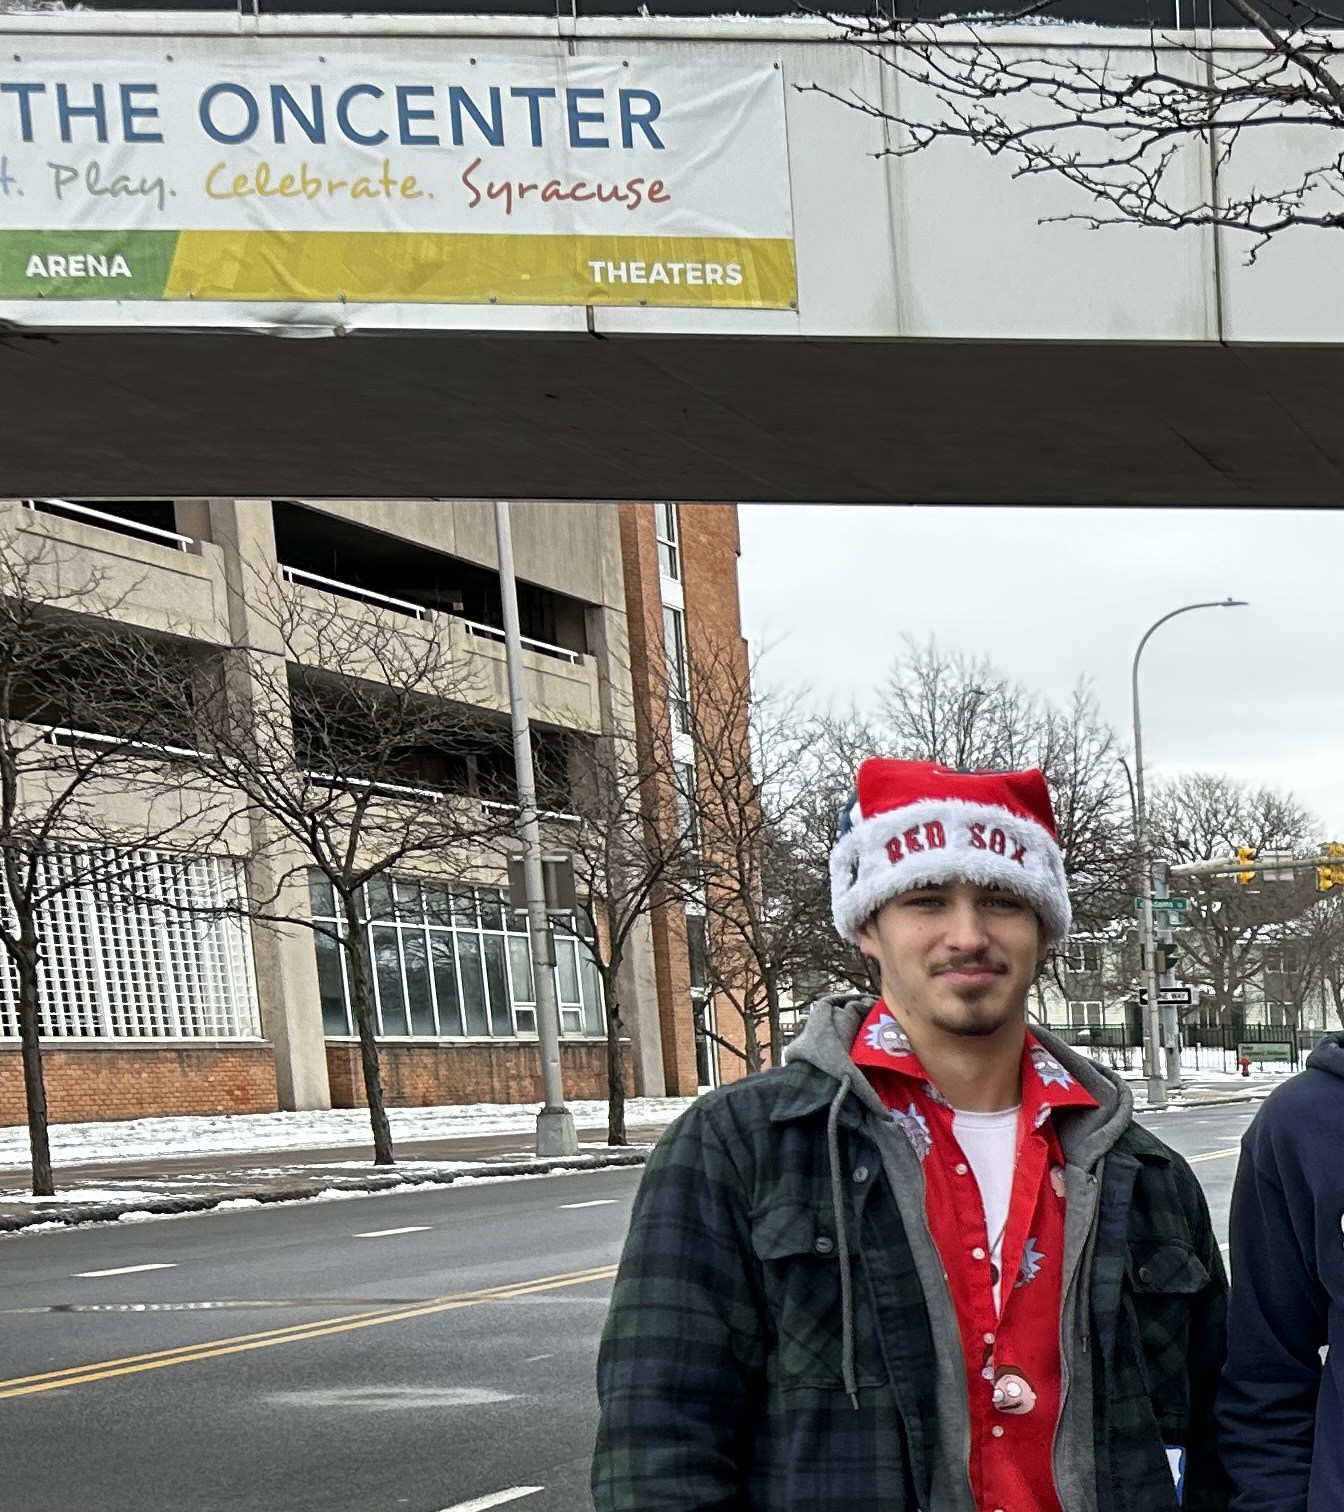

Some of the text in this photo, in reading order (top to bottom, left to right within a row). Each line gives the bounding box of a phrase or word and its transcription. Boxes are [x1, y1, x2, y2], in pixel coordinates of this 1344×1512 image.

[0, 82, 666, 150] THE ONCENTER
[47, 161, 177, 211] Play.
[204, 158, 435, 200] Celebrate.
[461, 157, 671, 215] Syracuse
[25, 254, 132, 278] ARENA
[588, 260, 743, 286] THEATERS
[885, 820, 1027, 867] RED SOX
